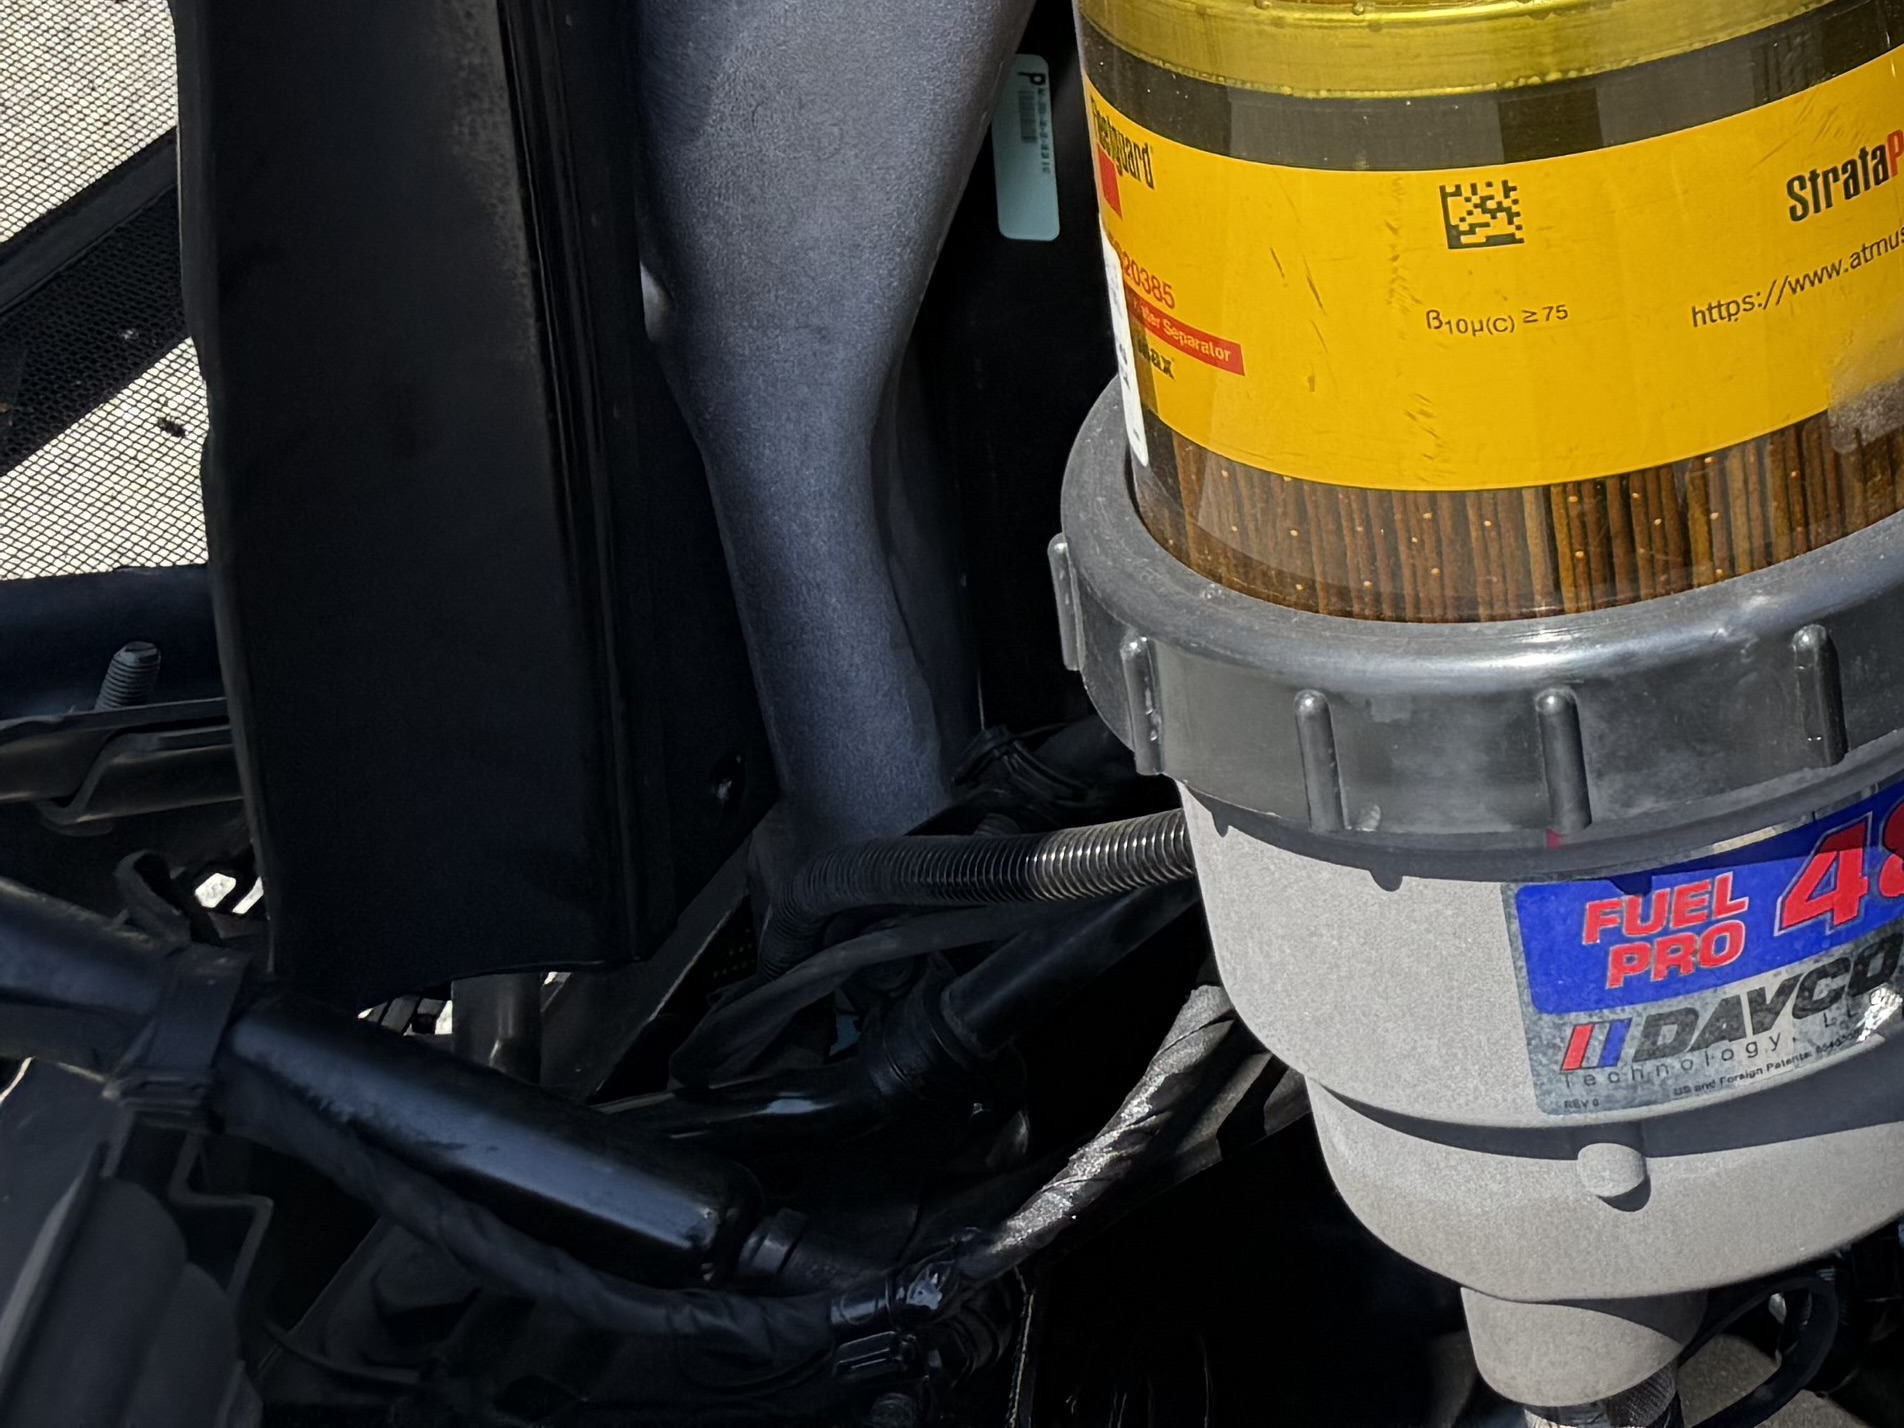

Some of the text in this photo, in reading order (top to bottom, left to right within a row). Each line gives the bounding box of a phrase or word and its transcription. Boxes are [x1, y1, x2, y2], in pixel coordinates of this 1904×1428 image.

[1016, 71, 1046, 86] P
[1542, 304, 1568, 321] 75
[1163, 318, 1231, 362] Separator
[1582, 871, 1750, 945] FUEL
[1605, 918, 1746, 990] PRO
[1633, 930, 1904, 1063] DAVCO
[1694, 1080, 1716, 1094] and
[1720, 1068, 1764, 1090] Foreign
